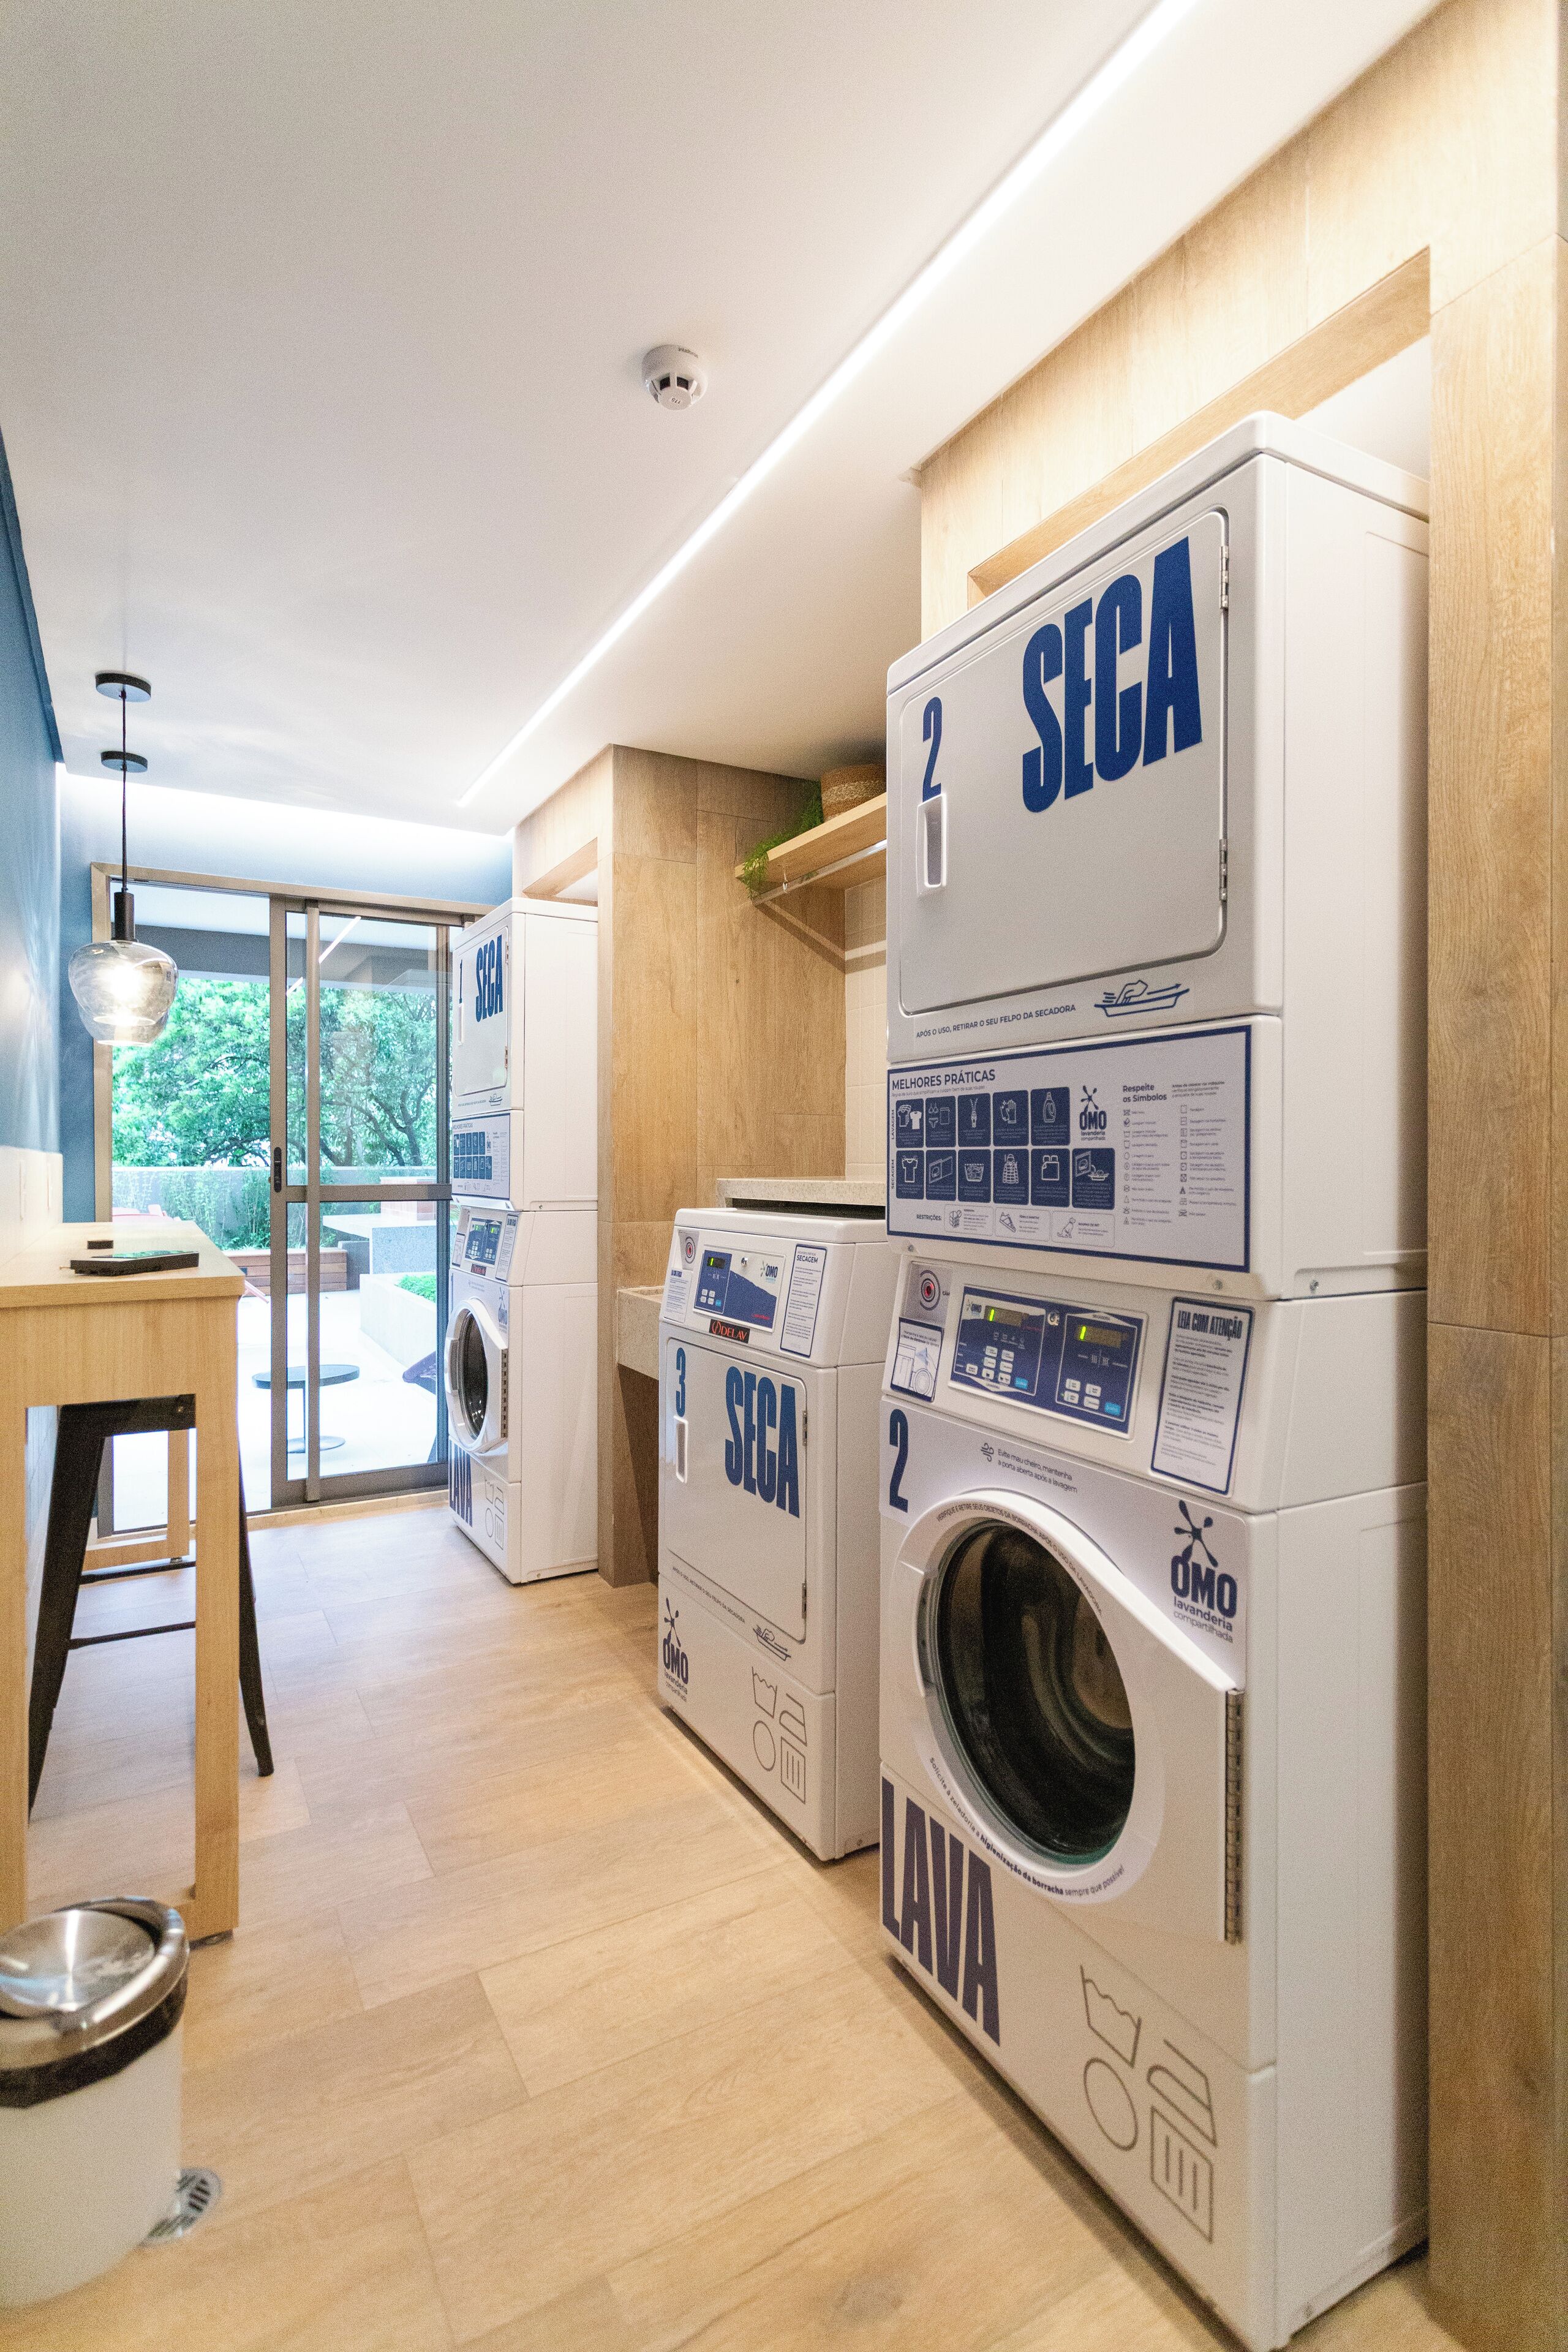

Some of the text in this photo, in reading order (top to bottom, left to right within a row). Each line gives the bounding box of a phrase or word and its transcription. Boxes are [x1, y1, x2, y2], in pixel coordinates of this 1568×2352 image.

[922, 536, 1202, 813] 2 SECA
[459, 935, 503, 1023] 1 SECA
[916, 1028, 931, 1038] APÓS
[938, 1027, 951, 1035] USO,
[952, 1021, 978, 1032] RETIRAR
[1000, 1014, 1021, 1023] FELPO
[1035, 1005, 1076, 1018] SECADORA
[892, 1069, 995, 1090] MELHORES PRÁTICAS
[1123, 1084, 1155, 1093] Respeite
[1133, 1093, 1167, 1102] Símbolos
[1079, 1110, 1107, 1130] OMO
[766, 1265, 778, 1278] OMO
[797, 1254, 818, 1264] SECAGEM
[499, 1307, 508, 1325] OMO
[1177, 1310, 1243, 1341] LEIA COM ATENÇÃO
[676, 1348, 799, 1518] 3 SECA
[889, 1409, 908, 1514] 2
[998, 1449, 1011, 1458] Evite
[1011, 1455, 1023, 1463] mau
[1042, 1465, 1072, 1481] mantenha
[1002, 1461, 1016, 1471] porta
[1016, 1466, 1034, 1477] aberta
[1034, 1474, 1047, 1483] após
[1052, 1477, 1077, 1493] lavagem
[450, 1439, 473, 1528] LAVA
[984, 1505, 1004, 1517] OBJETOS
[1171, 1555, 1237, 1618] OMO
[1174, 1596, 1233, 1632] lavanderia
[1174, 1610, 1233, 1643] compartilhada
[663, 1638, 688, 1684] OMO
[664, 1667, 687, 1695] lavanderia
[930, 1757, 947, 1790] Solicite
[950, 1796, 976, 1833] zeladoria
[980, 1834, 1022, 1875] higienização
[1022, 1872, 1031, 1882] da
[1032, 1876, 1064, 1895] borracha
[1065, 1888, 1089, 1897] sempre
[1090, 1883, 1102, 1894] que
[1102, 1864, 1125, 1890] possível
[882, 1776, 1000, 2047] LAVA
